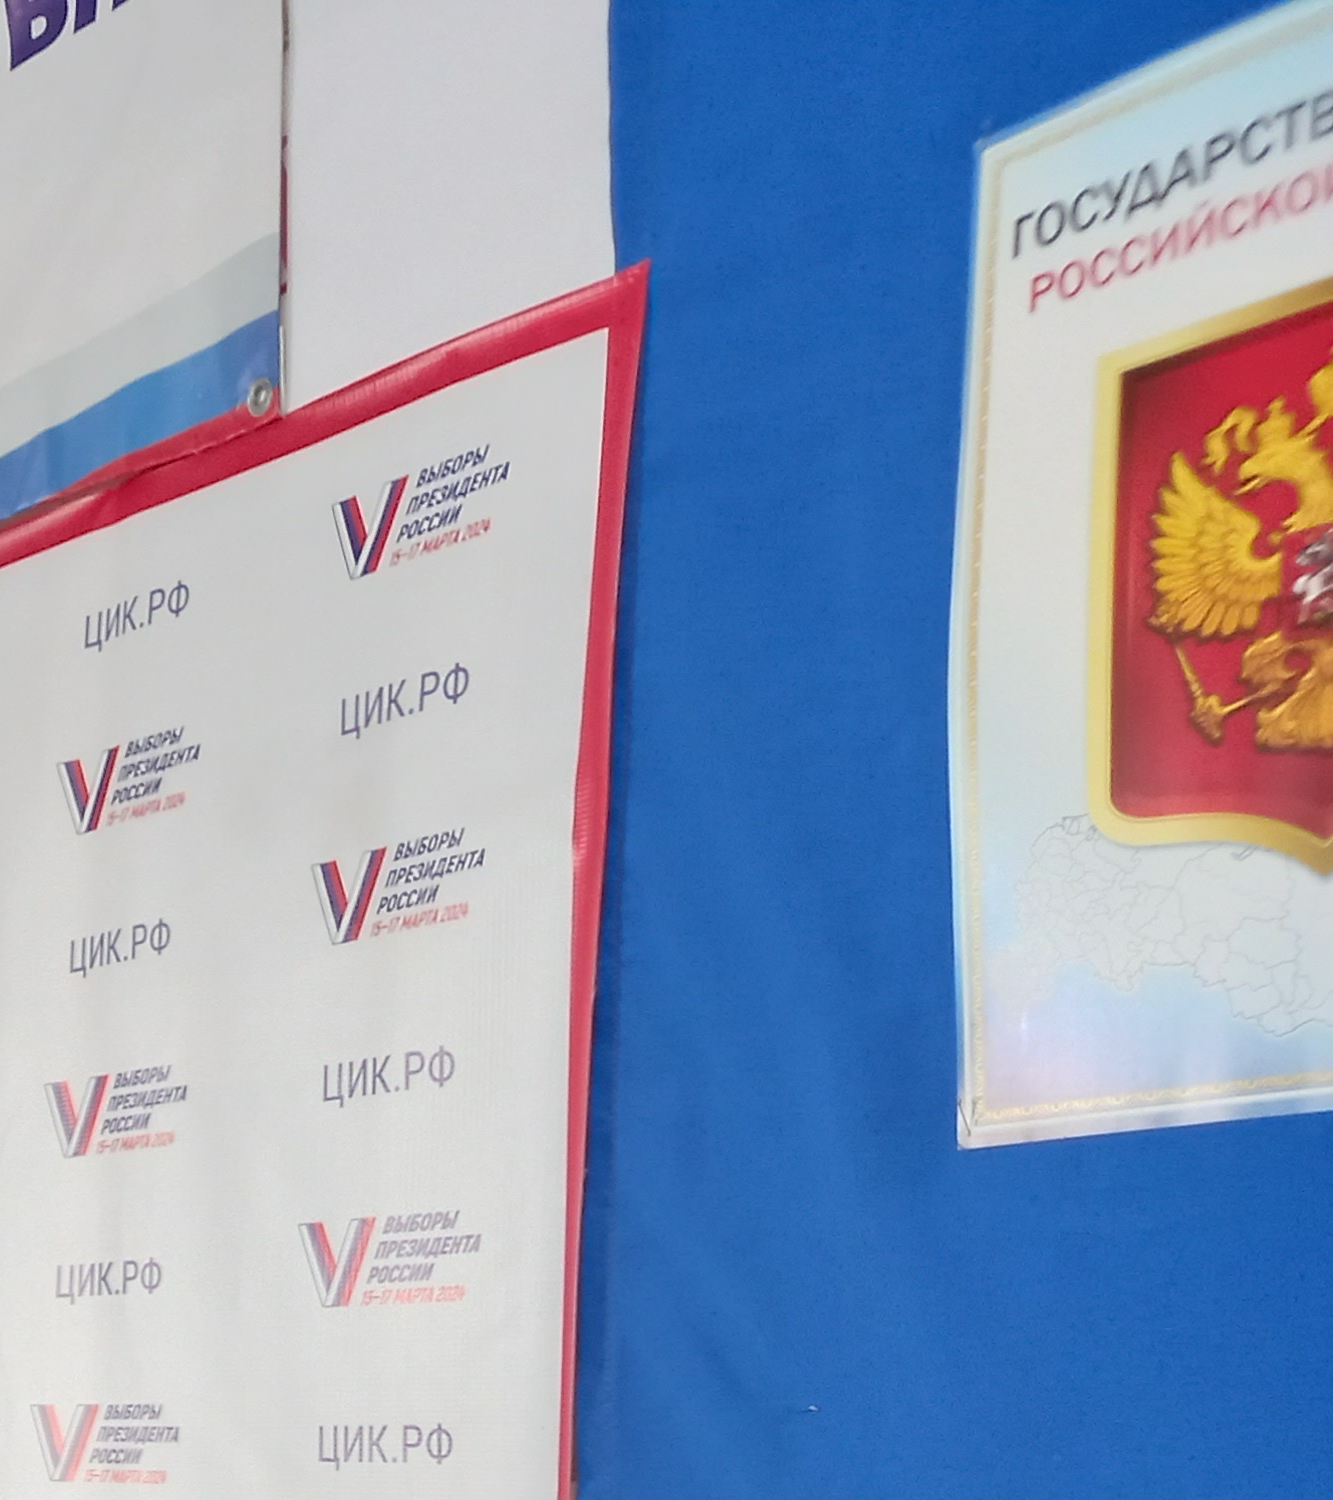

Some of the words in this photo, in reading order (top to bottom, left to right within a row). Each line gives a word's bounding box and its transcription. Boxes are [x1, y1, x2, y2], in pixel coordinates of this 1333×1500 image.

[414, 442, 492, 489] ВЫБОРЫ
[403, 460, 511, 517] ПРЕЗИДЕНТА
[394, 503, 462, 545] РОССИИ
[85, 580, 189, 652] ЦИК.РФ
[341, 663, 469, 739] ЦИК.РФ
[125, 726, 184, 758] ВЫБОРЫ
[111, 776, 162, 806] РОССИИ
[393, 827, 466, 862] ВЫБОРЫ
[383, 848, 485, 888] ПРЕЗИДЕНТА
[374, 883, 440, 915] РОССИИ
[70, 918, 170, 978] ЦИК.РФ
[112, 1064, 173, 1089] ВЫБОРЫ
[323, 1046, 455, 1108] ЦИК.РФ
[105, 1084, 188, 1112] ПРЕЗИДЕНТА
[98, 1112, 151, 1135] РОССИИ
[383, 1211, 460, 1233] ВЫБОРЫ
[56, 1257, 162, 1305] ЦИК.РФ
[366, 1262, 433, 1284] РОССИИ
[319, 1423, 453, 1471] ЦИК.РФ
